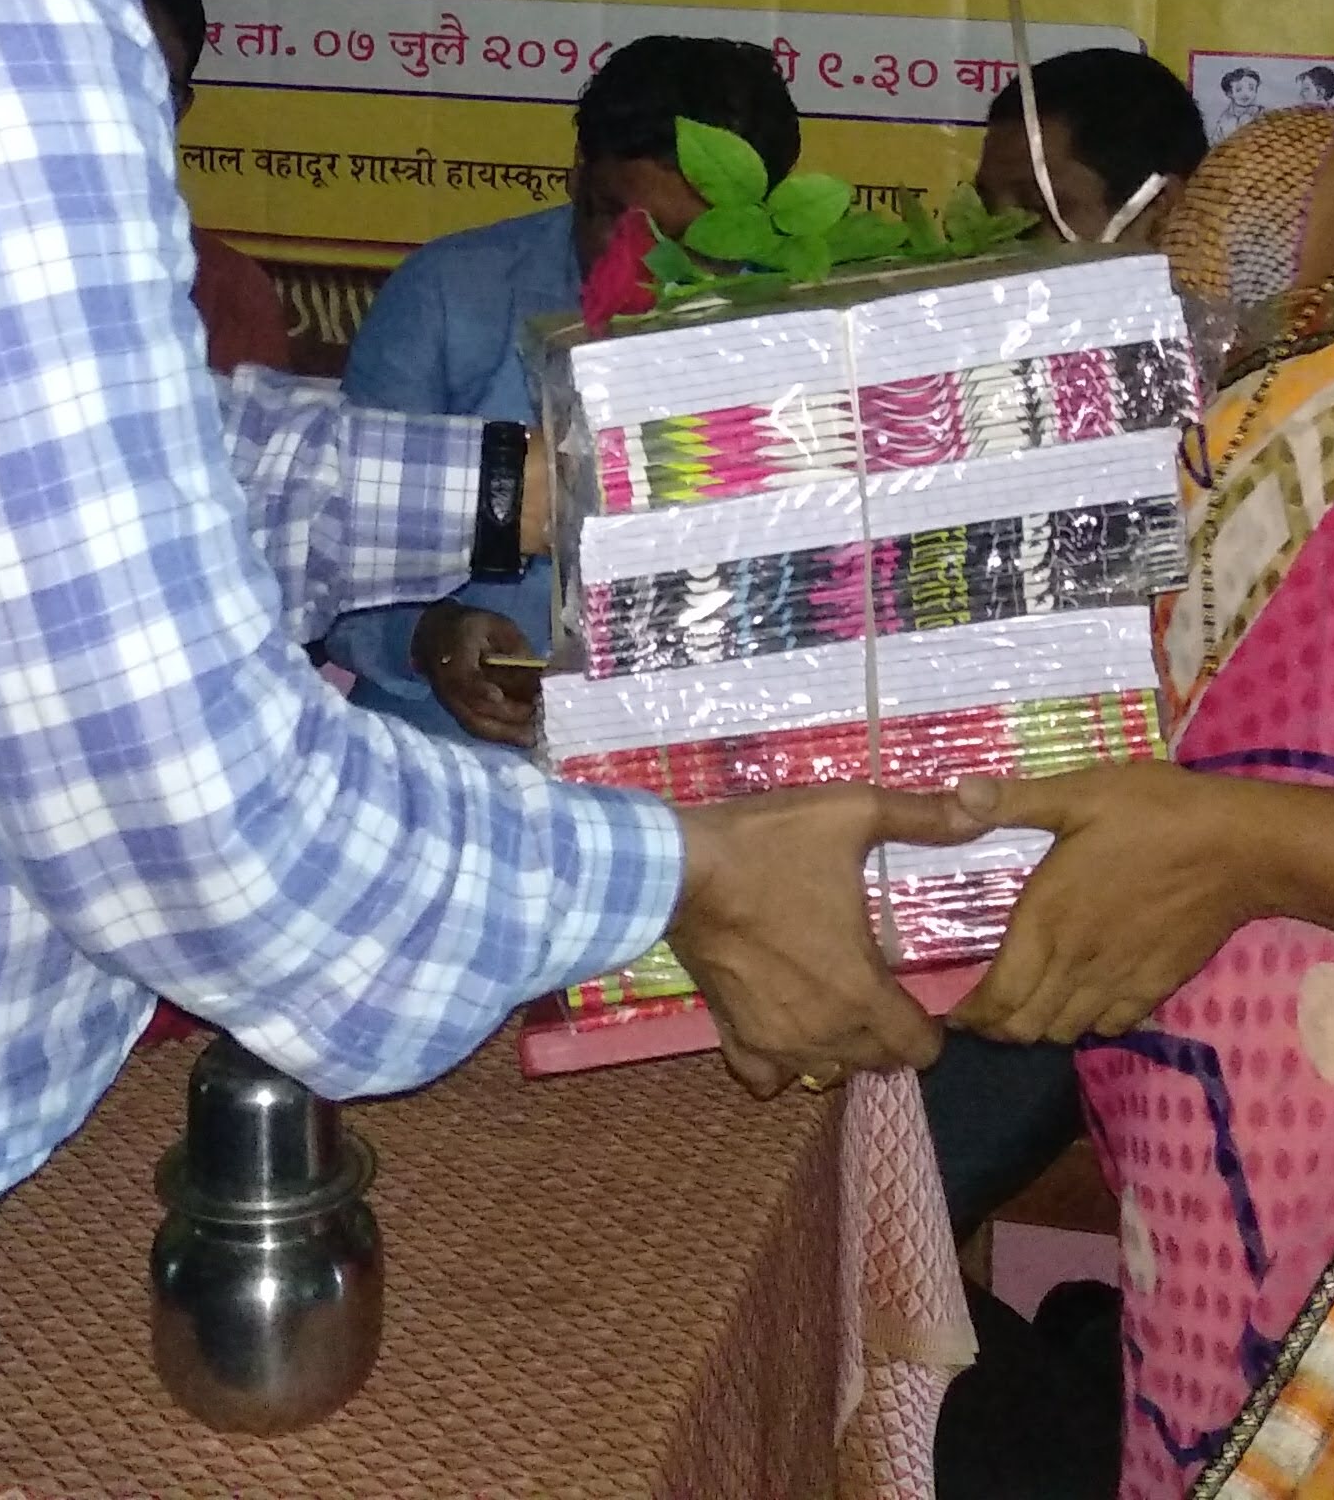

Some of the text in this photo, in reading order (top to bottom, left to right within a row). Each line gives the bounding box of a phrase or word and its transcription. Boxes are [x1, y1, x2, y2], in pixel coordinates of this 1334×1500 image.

[235, 23, 297, 57] ता.
[313, 29, 376, 62] ०७
[388, 12, 469, 78] जुलै
[818, 52, 939, 97] ९.३०
[179, 143, 246, 175] लाल
[348, 146, 437, 188] शास्त्री
[443, 159, 573, 202] हायस्कूल
